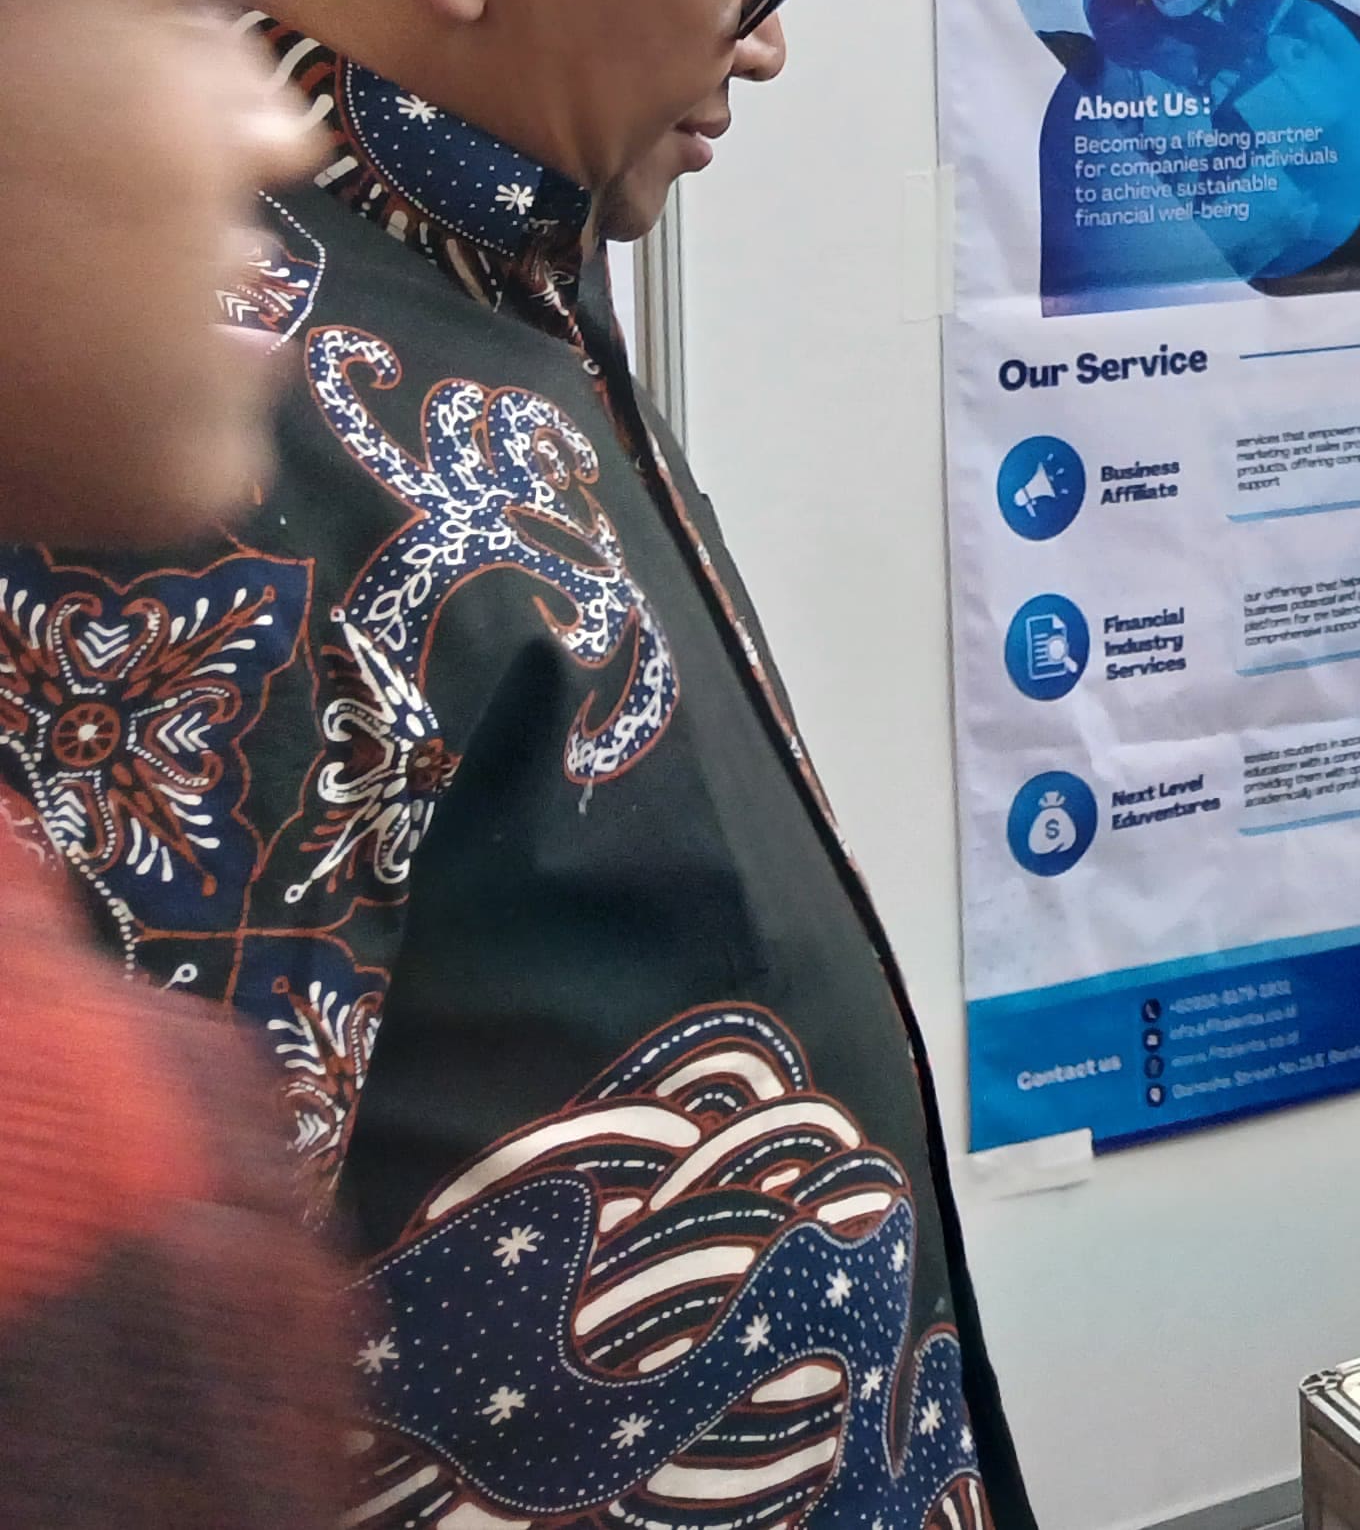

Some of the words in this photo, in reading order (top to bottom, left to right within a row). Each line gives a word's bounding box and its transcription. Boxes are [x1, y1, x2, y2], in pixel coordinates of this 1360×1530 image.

[1074, 94, 1159, 121] About
[1074, 133, 1167, 156] Becoming
[1170, 136, 1182, 150] a
[1187, 129, 1251, 158] lifelong
[1254, 126, 1324, 150] partner
[1074, 159, 1106, 179] for
[1110, 156, 1209, 180] companies
[1212, 150, 1247, 171] and
[1250, 147, 1338, 169] individuals
[1075, 185, 1098, 203] to
[1101, 180, 1173, 202] achieve
[1177, 174, 1278, 198] sustainable
[1075, 208, 1155, 228] financial
[1158, 201, 1251, 223] well-being
[998, 359, 1069, 392] Our
[1075, 344, 1208, 385] Service
[1236, 434, 1280, 448] services
[1282, 430, 1305, 445] that
[1236, 445, 1290, 463] marketing
[1292, 443, 1313, 457] and
[1100, 461, 1180, 483] Business
[1237, 476, 1280, 492] support
[1100, 483, 1179, 506] Affiliate
[1244, 589, 1261, 603] our
[1316, 580, 1338, 593] that
[1103, 606, 1185, 635] Financial
[1294, 612, 1311, 625] for
[1104, 633, 1184, 657] Industry
[1105, 655, 1187, 681] Services
[1111, 784, 1155, 809] Next
[1157, 774, 1204, 799] Level
[1111, 796, 1222, 831] Eduventures
[1017, 1058, 1097, 1091] Contact
[1099, 1055, 1122, 1072] us
